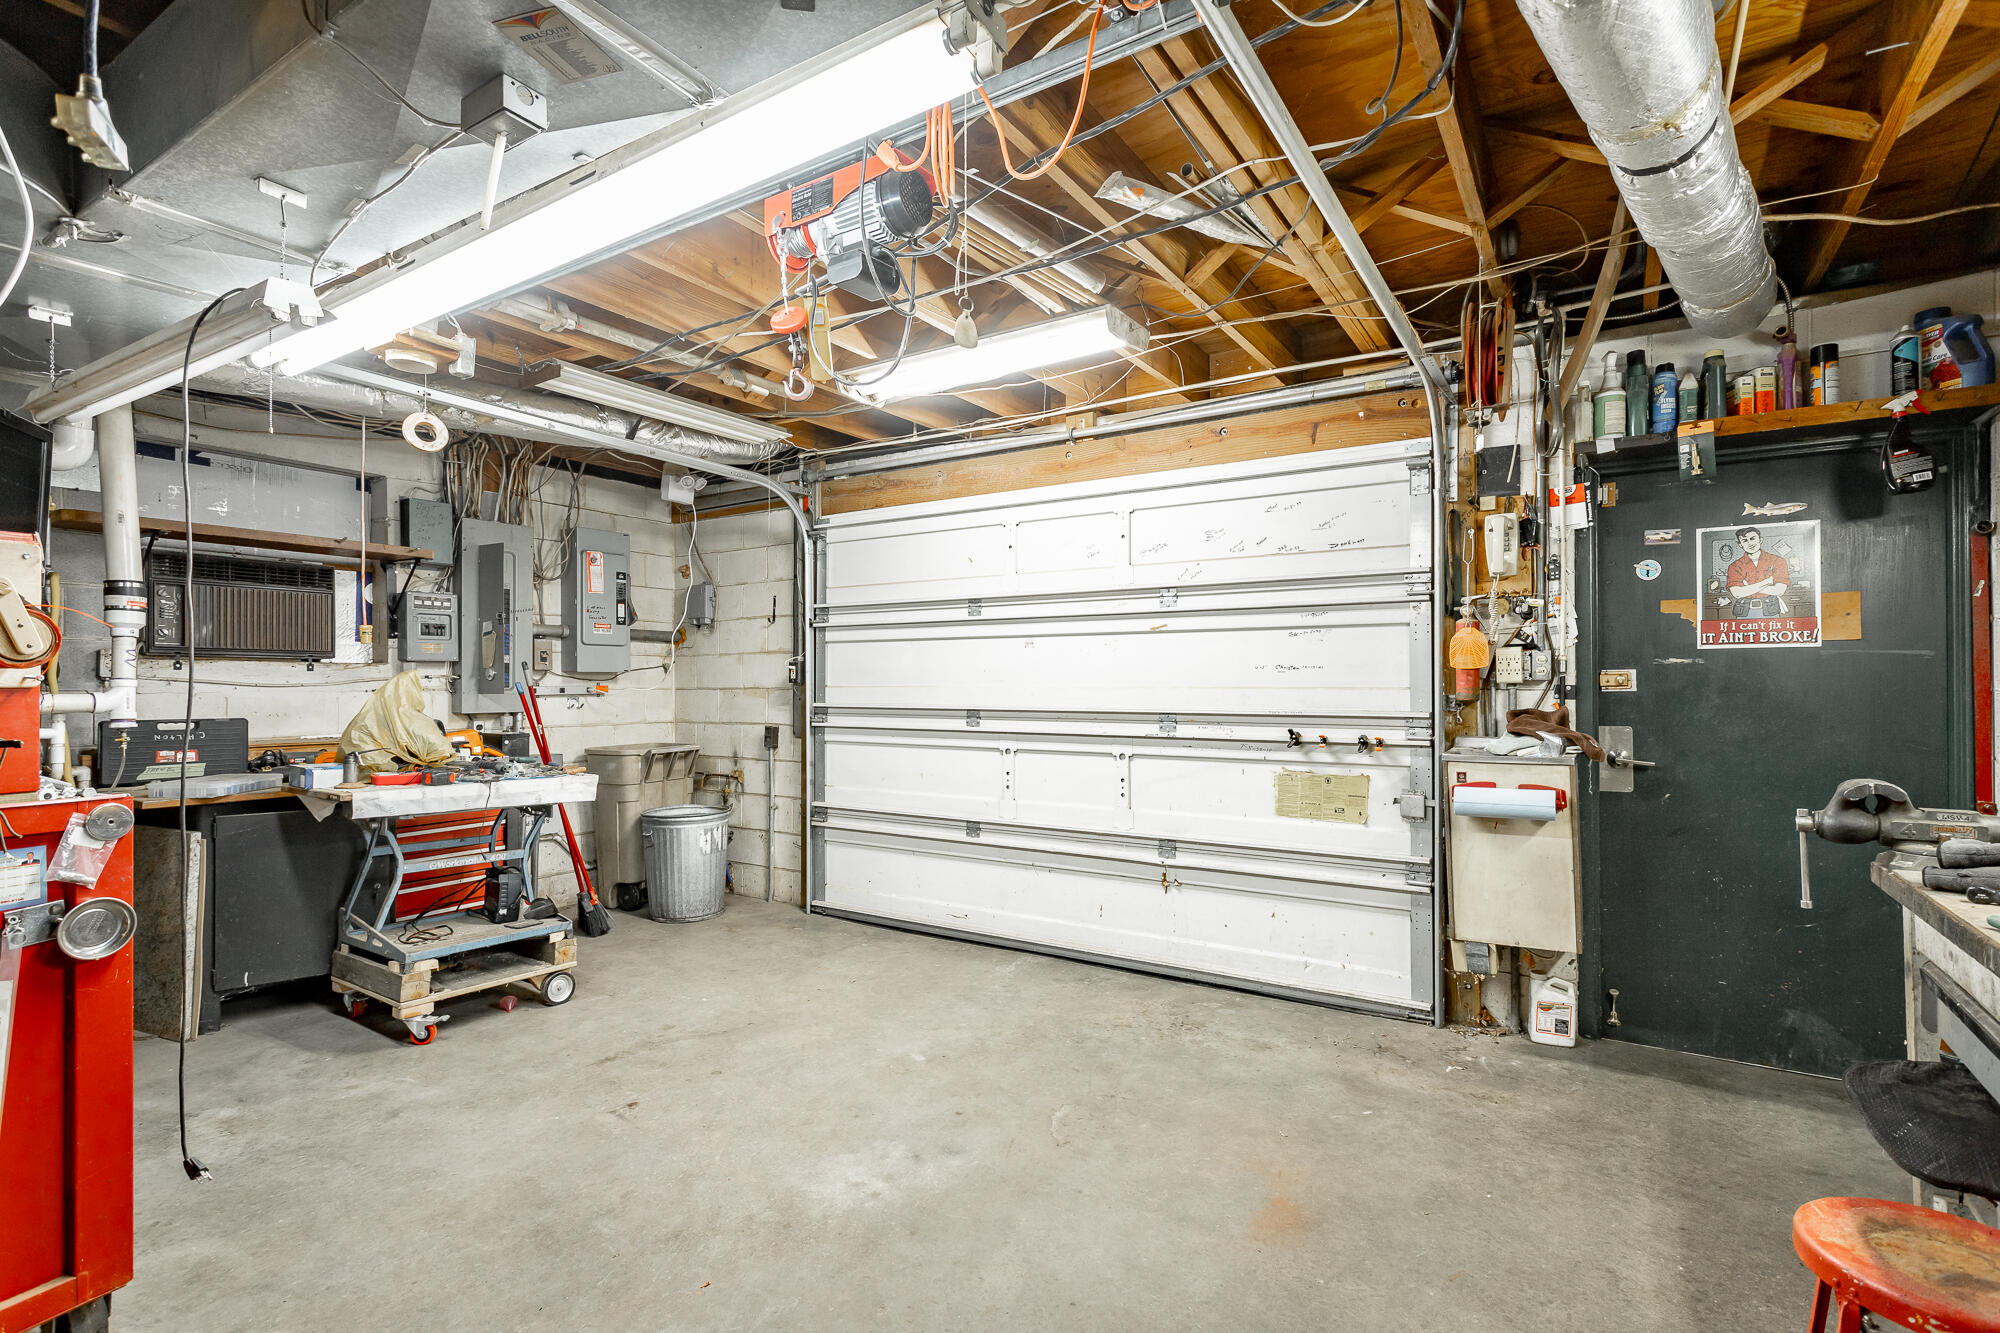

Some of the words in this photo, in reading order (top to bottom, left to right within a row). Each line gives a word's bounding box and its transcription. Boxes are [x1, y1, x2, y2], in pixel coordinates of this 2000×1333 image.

[520, 26, 569, 42] BELLSOUTH
[1720, 621, 1729, 632] If
[1732, 622, 1737, 630] I
[1740, 620, 1766, 630] can't
[1769, 620, 1782, 631] fix
[1786, 620, 1795, 629] it
[1701, 633, 1716, 644] IT
[1718, 631, 1757, 644] AIN'T
[1760, 628, 1820, 644] BROKE!
[1900, 823, 1917, 839] 4
